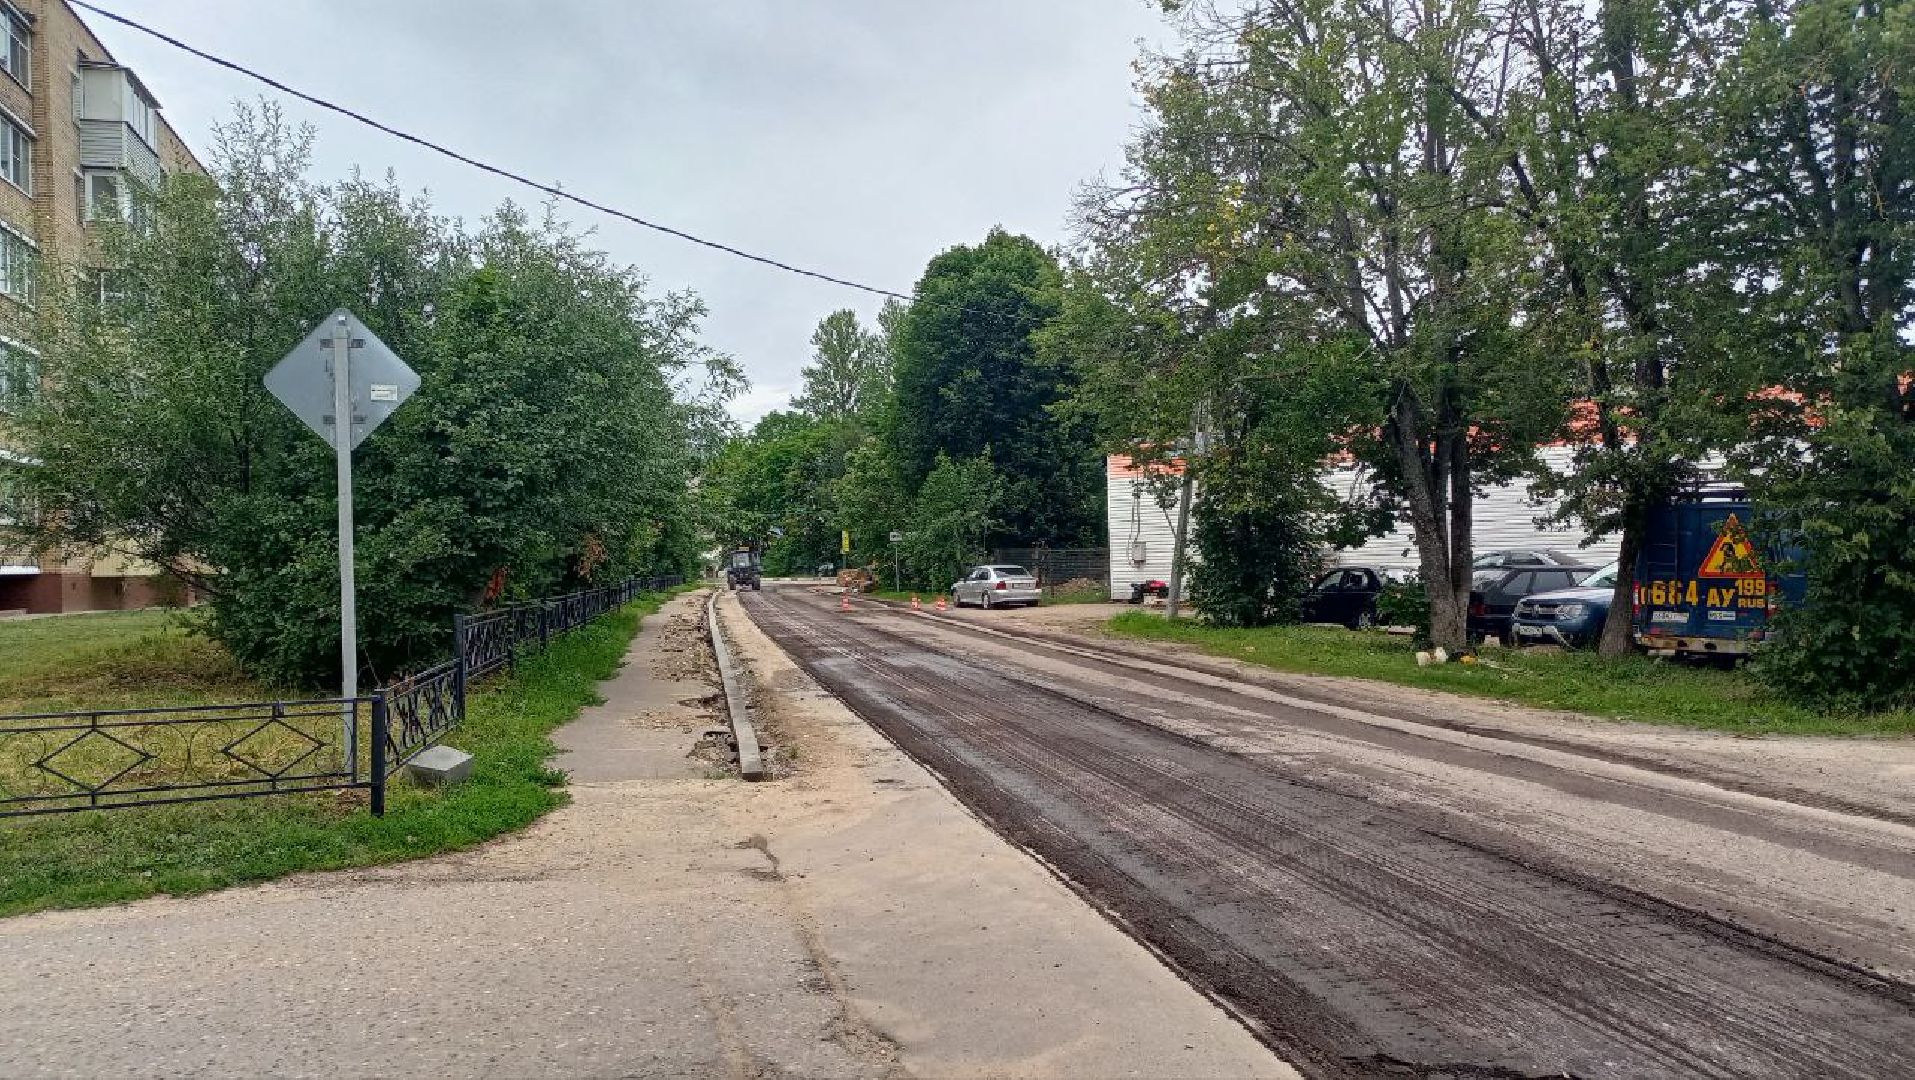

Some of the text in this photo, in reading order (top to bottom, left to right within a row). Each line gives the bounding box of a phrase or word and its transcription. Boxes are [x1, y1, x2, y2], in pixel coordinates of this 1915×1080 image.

[1707, 588, 1735, 608] АУ
[1735, 579, 1765, 596] 199
[1738, 598, 1765, 608] RUS
